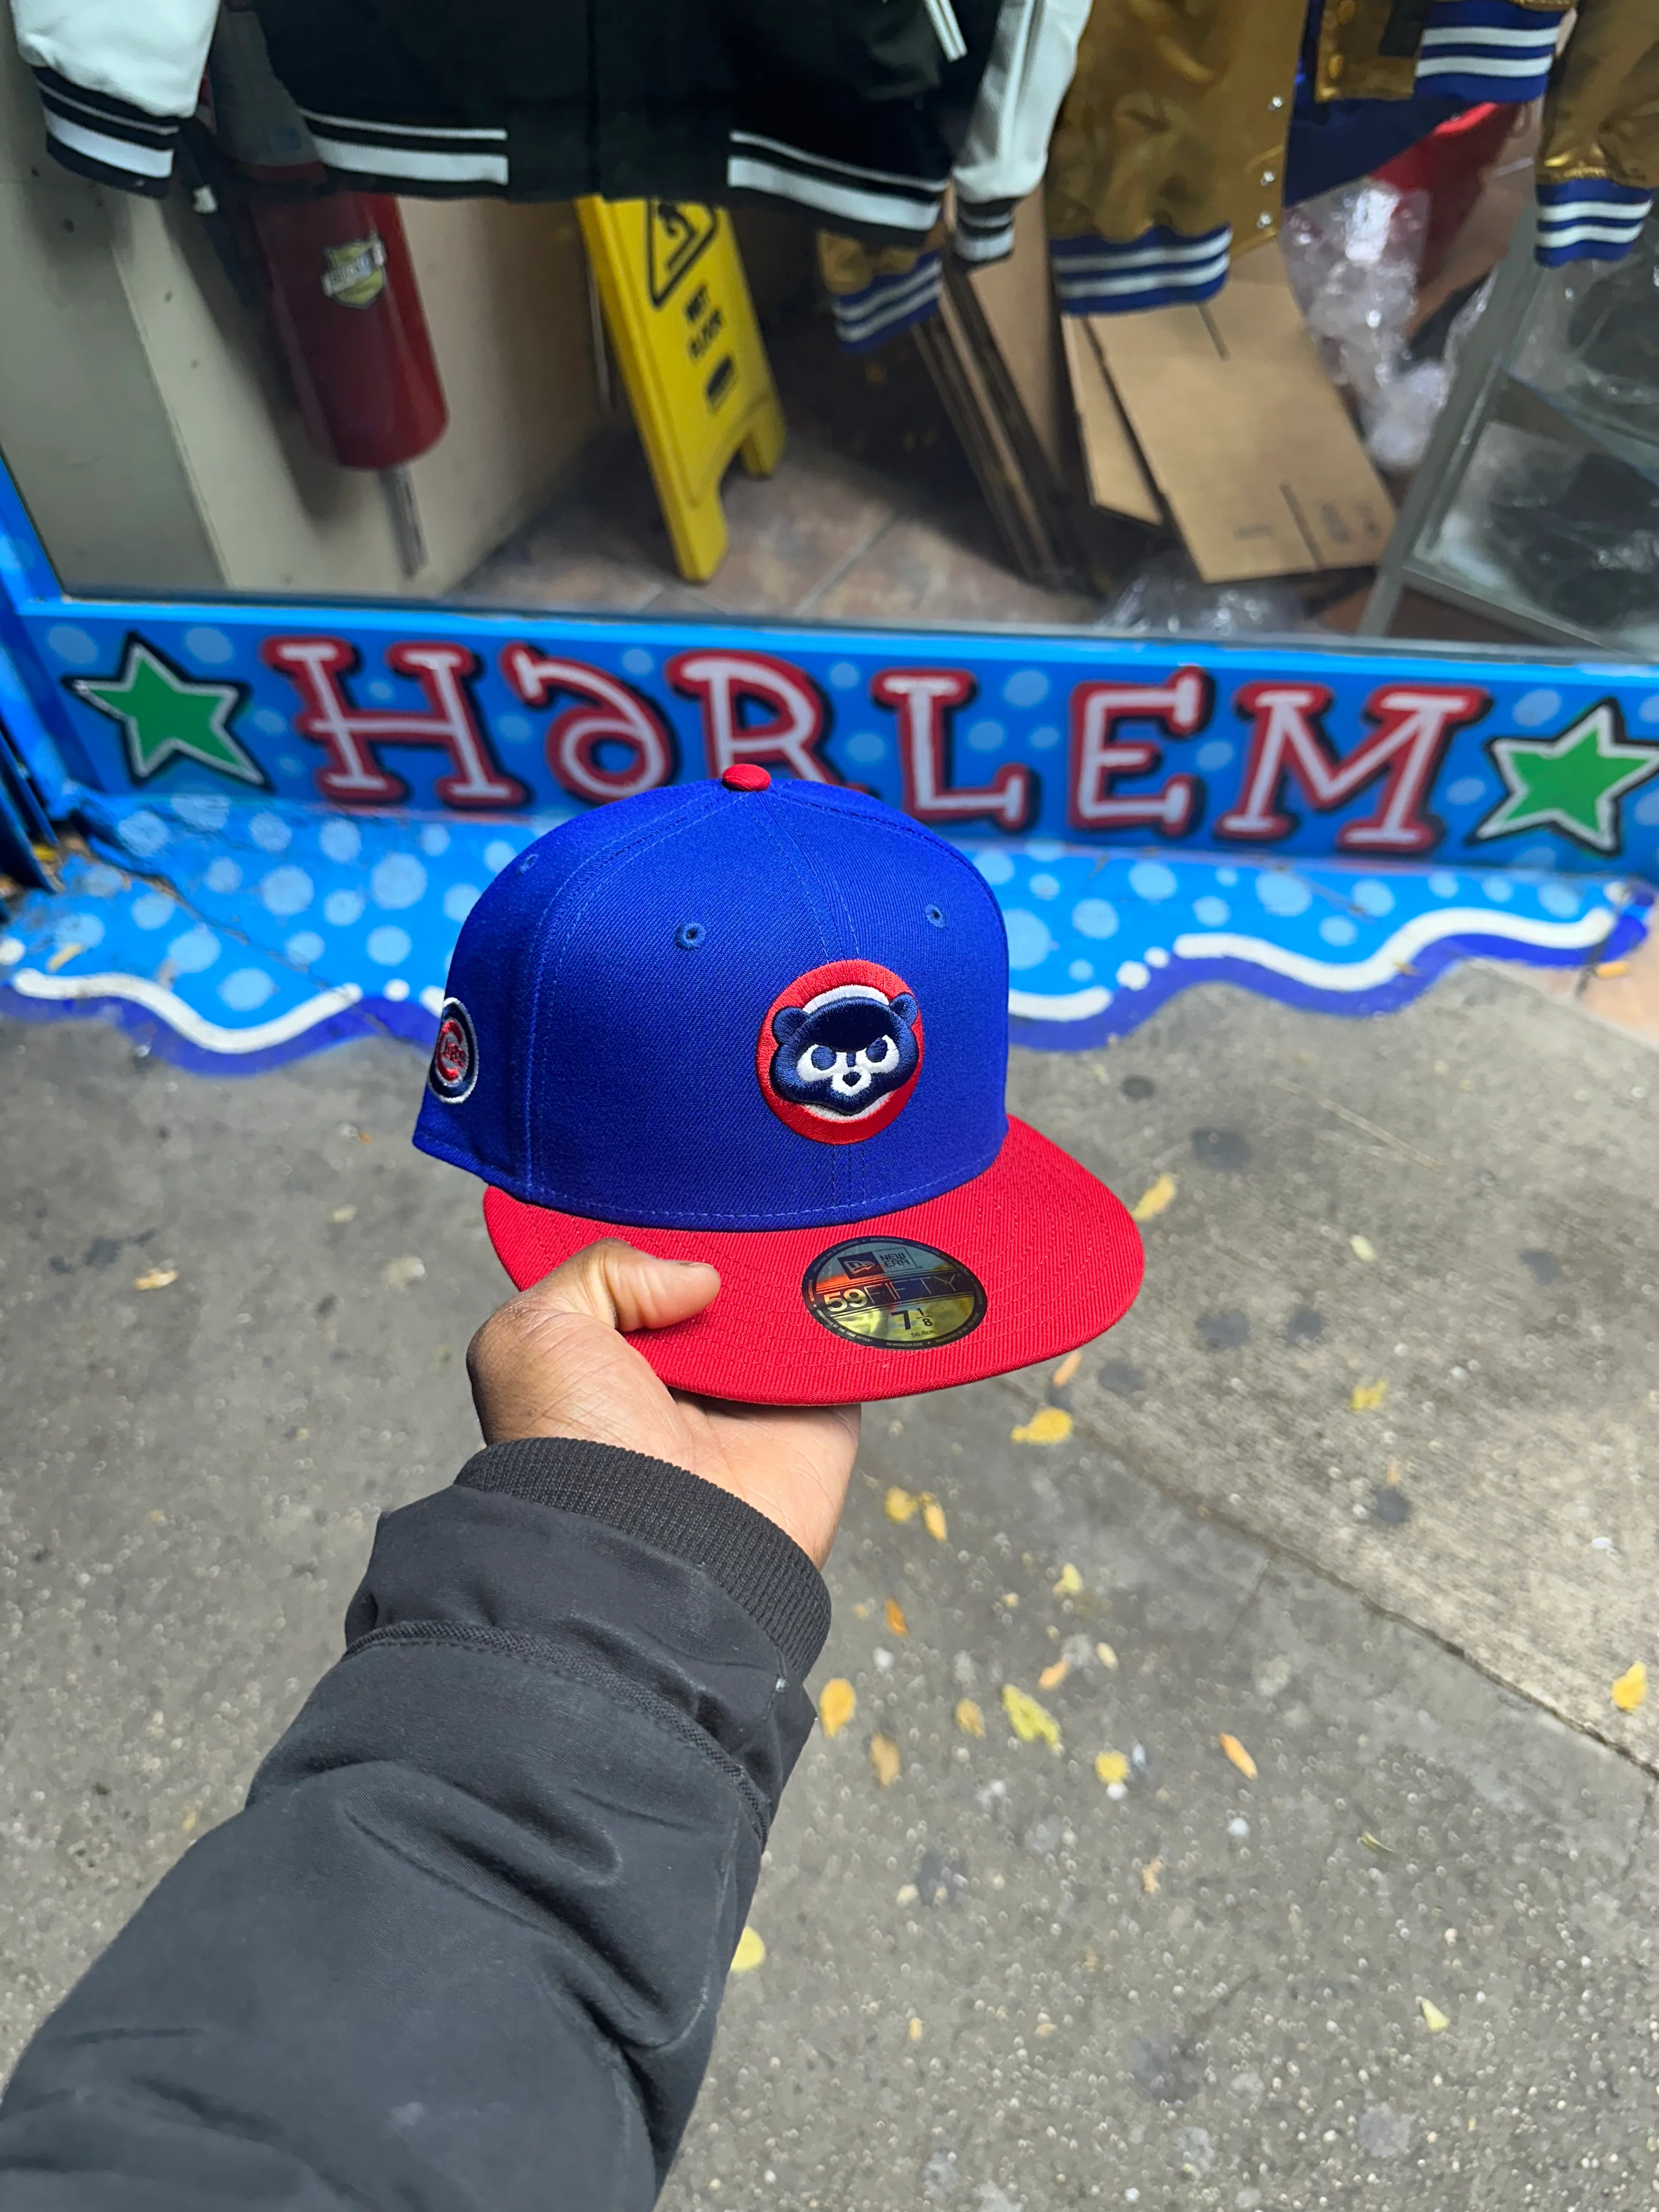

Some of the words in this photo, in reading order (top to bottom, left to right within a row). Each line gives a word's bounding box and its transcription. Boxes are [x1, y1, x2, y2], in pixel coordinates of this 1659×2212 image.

[879, 1252, 906, 1261] NEW
[883, 1259, 911, 1268] ERA
[824, 1273, 957, 1313] 59FIFTY
[890, 1310, 911, 1330] 7
